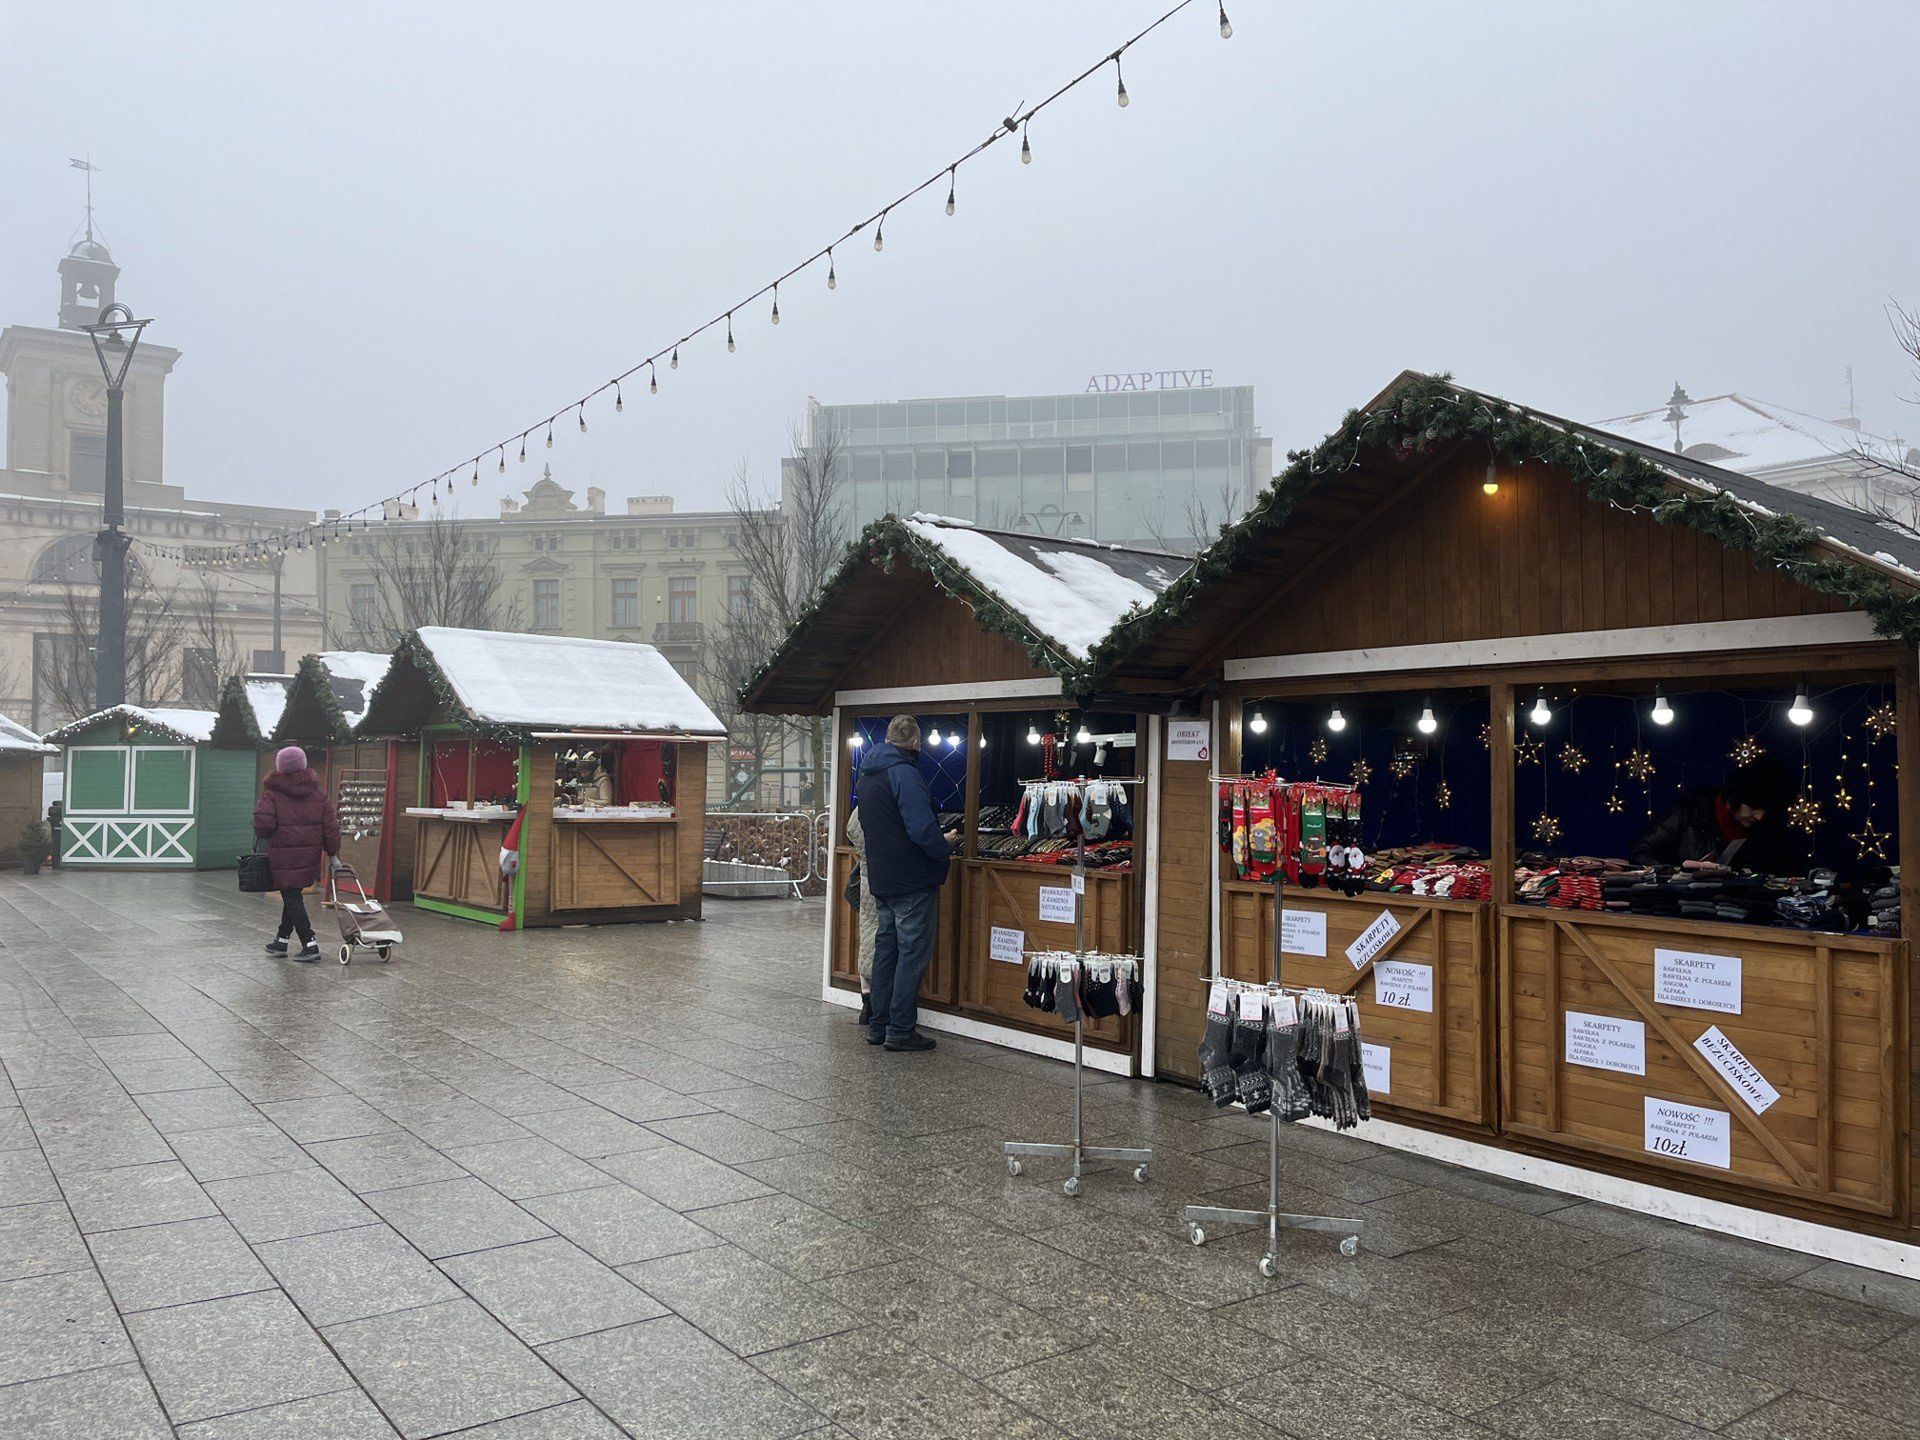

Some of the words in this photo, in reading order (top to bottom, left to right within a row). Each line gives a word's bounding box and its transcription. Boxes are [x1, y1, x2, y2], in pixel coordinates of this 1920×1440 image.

[1085, 369, 1214, 392] ADAPTIVE
[1285, 915, 1311, 923] SKARPETY
[1356, 916, 1390, 954] SKARPETY
[1356, 927, 1396, 968] BEZUCISKOWE
[1674, 958, 1716, 970] SKARPETY
[1385, 967, 1416, 977] NOWOŚĆ
[1663, 981, 1688, 989] ANGORA
[1702, 978, 1731, 987] POLAREM
[1382, 991, 1395, 1003] 10
[1398, 993, 1411, 1006] zł.
[1670, 995, 1691, 1003] DZIECI
[1584, 1021, 1621, 1032] SKARPETY
[1573, 1042, 1596, 1050] ANGORA
[1609, 1040, 1635, 1049] POLAREM
[1573, 1048, 1594, 1056] ALPAKA
[1718, 1038, 1763, 1083] SKARPETY
[1702, 1037, 1764, 1102] BEZUCISKOWE
[1657, 1108, 1700, 1123] NOWOŚĆ
[1704, 1117, 1714, 1125] !!!
[1665, 1119, 1696, 1130] SKARPETY
[1689, 1132, 1718, 1142] POLAREM
[1653, 1136, 1687, 1156] 10zł.
